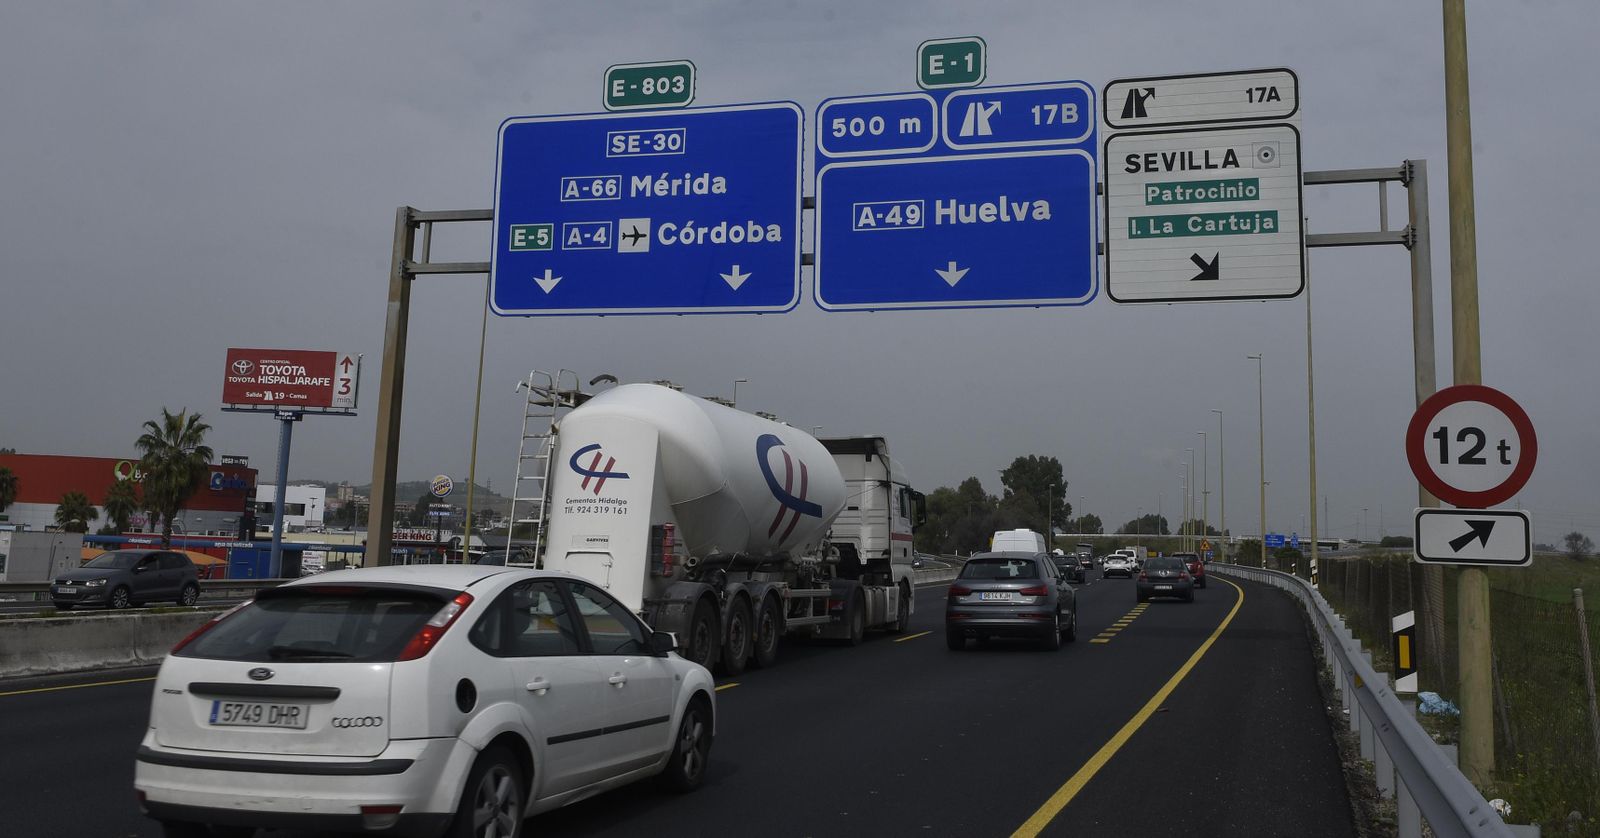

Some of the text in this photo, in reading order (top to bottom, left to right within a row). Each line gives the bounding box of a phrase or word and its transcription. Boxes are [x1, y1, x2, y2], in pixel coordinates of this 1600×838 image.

[1246, 87, 1280, 103] 17A
[1032, 103, 1078, 125] 17B
[833, 116, 920, 137] 500 m
[611, 133, 682, 153] SE-30
[1125, 149, 1239, 173] SEVILLA
[565, 173, 726, 198] A-66 Mérida
[1147, 182, 1257, 202] Patrocinio
[858, 196, 1051, 227] A-49 Huelva
[514, 221, 781, 246] E-5 A-4 Córdoba
[1150, 219, 1173, 234] La
[1187, 214, 1274, 234] Cartuja
[260, 364, 306, 376] TOYOTA
[258, 376, 330, 386] HISPALJARAFE
[338, 378, 351, 395] 3
[1433, 427, 1511, 465] 12 t
[434, 483, 450, 492] KING
[594, 506, 610, 514] 319
[613, 507, 628, 515] 161
[598, 498, 628, 506] Hidalgo
[222, 703, 301, 726] 5749 DHR
